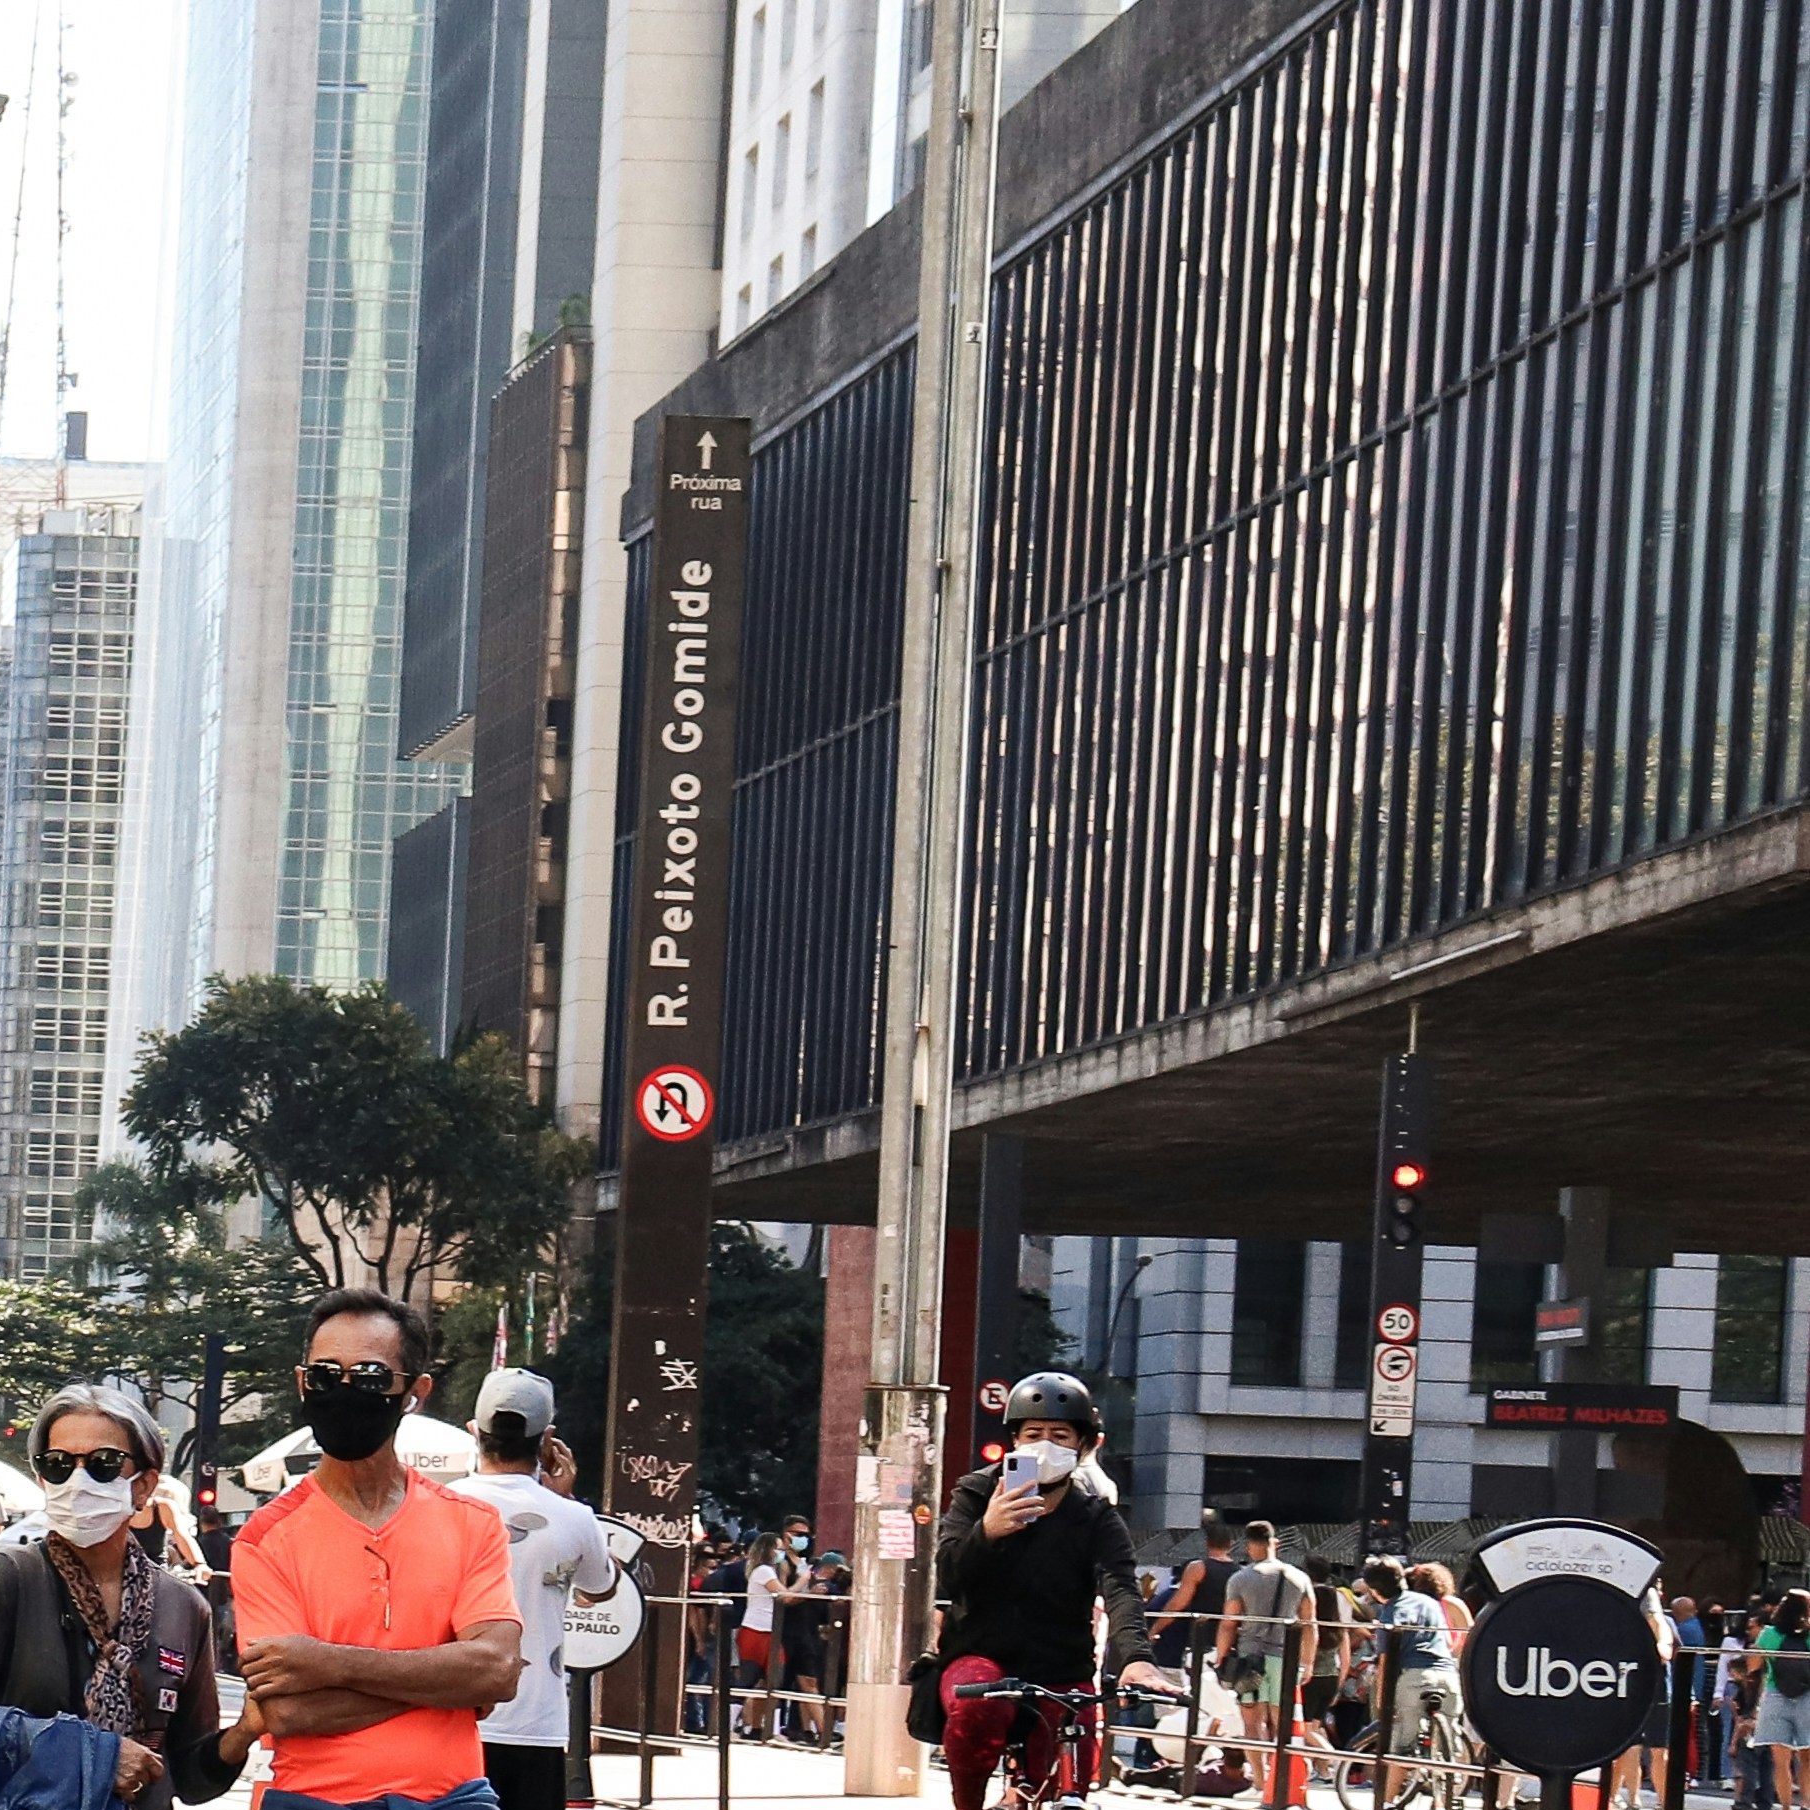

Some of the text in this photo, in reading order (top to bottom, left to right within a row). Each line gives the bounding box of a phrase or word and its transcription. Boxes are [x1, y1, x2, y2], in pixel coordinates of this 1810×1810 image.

[670, 473, 742, 491] Próxima
[691, 497, 722, 510] rua
[647, 559, 713, 1027] R. Peixoto Gomide
[1384, 1313, 1410, 1330] 50
[1493, 1405, 1668, 1425] BEATRIZ MILHAZES
[597, 1612, 611, 1622] DE
[576, 1622, 621, 1635] PAULO
[1496, 1646, 1639, 1698] Uber
